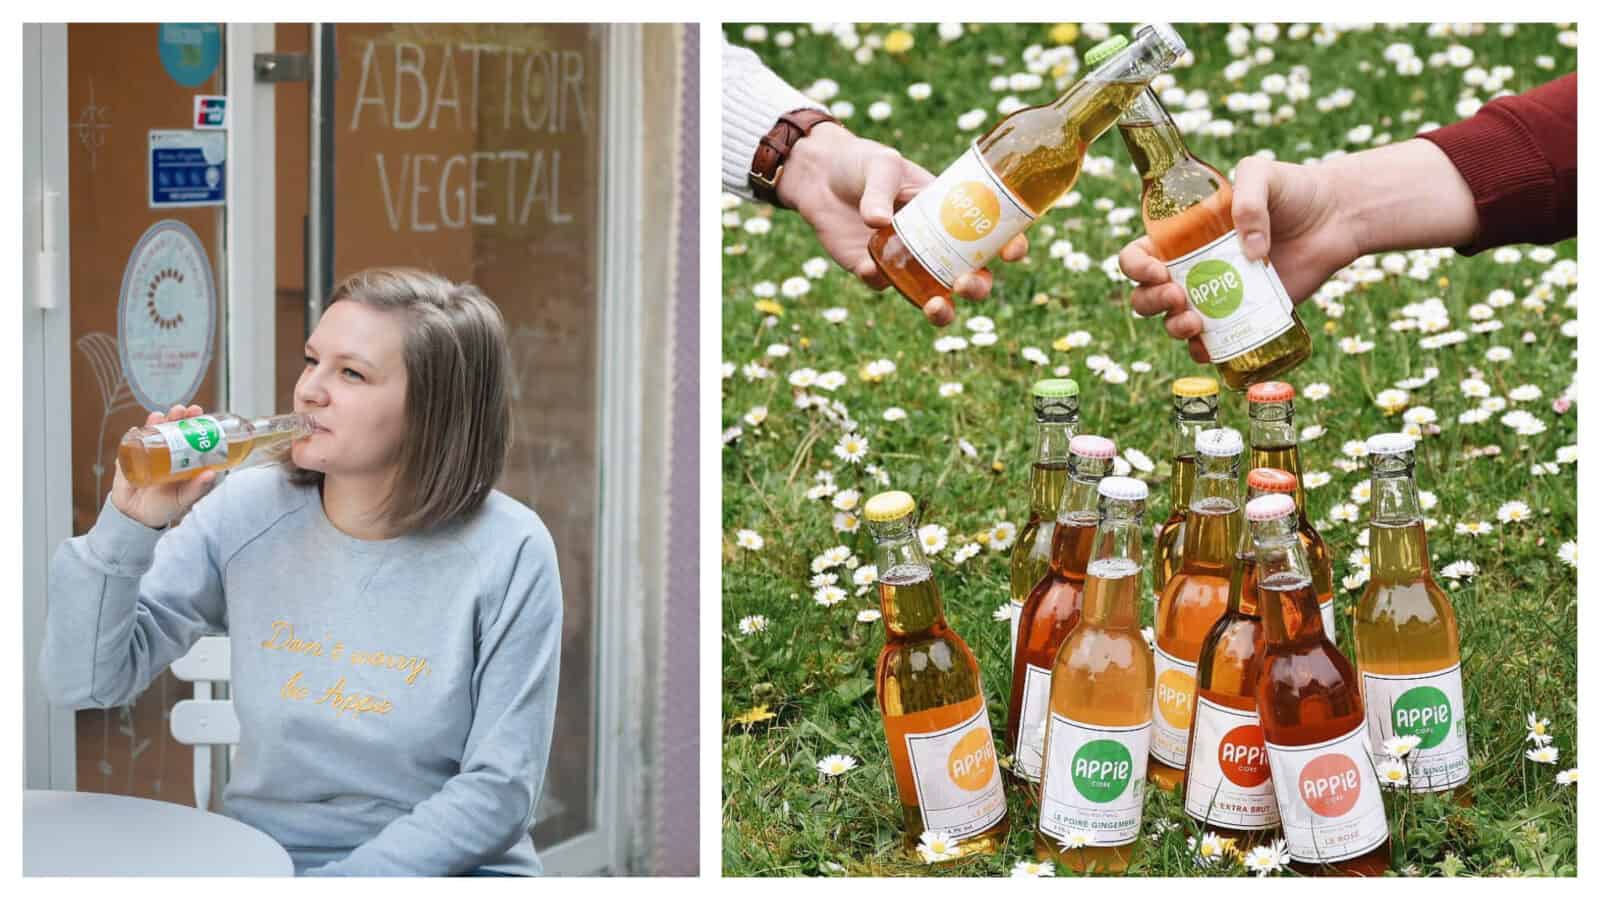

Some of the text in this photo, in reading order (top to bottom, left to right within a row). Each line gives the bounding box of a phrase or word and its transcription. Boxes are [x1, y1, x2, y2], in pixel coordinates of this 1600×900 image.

[350, 39, 590, 134] ABATTOIR
[375, 149, 575, 232] VEGETAL
[259, 619, 345, 662] Don't
[280, 671, 394, 720] be Appie
[1159, 684, 1193, 711] APPi
[1222, 742, 1269, 766] APPi
